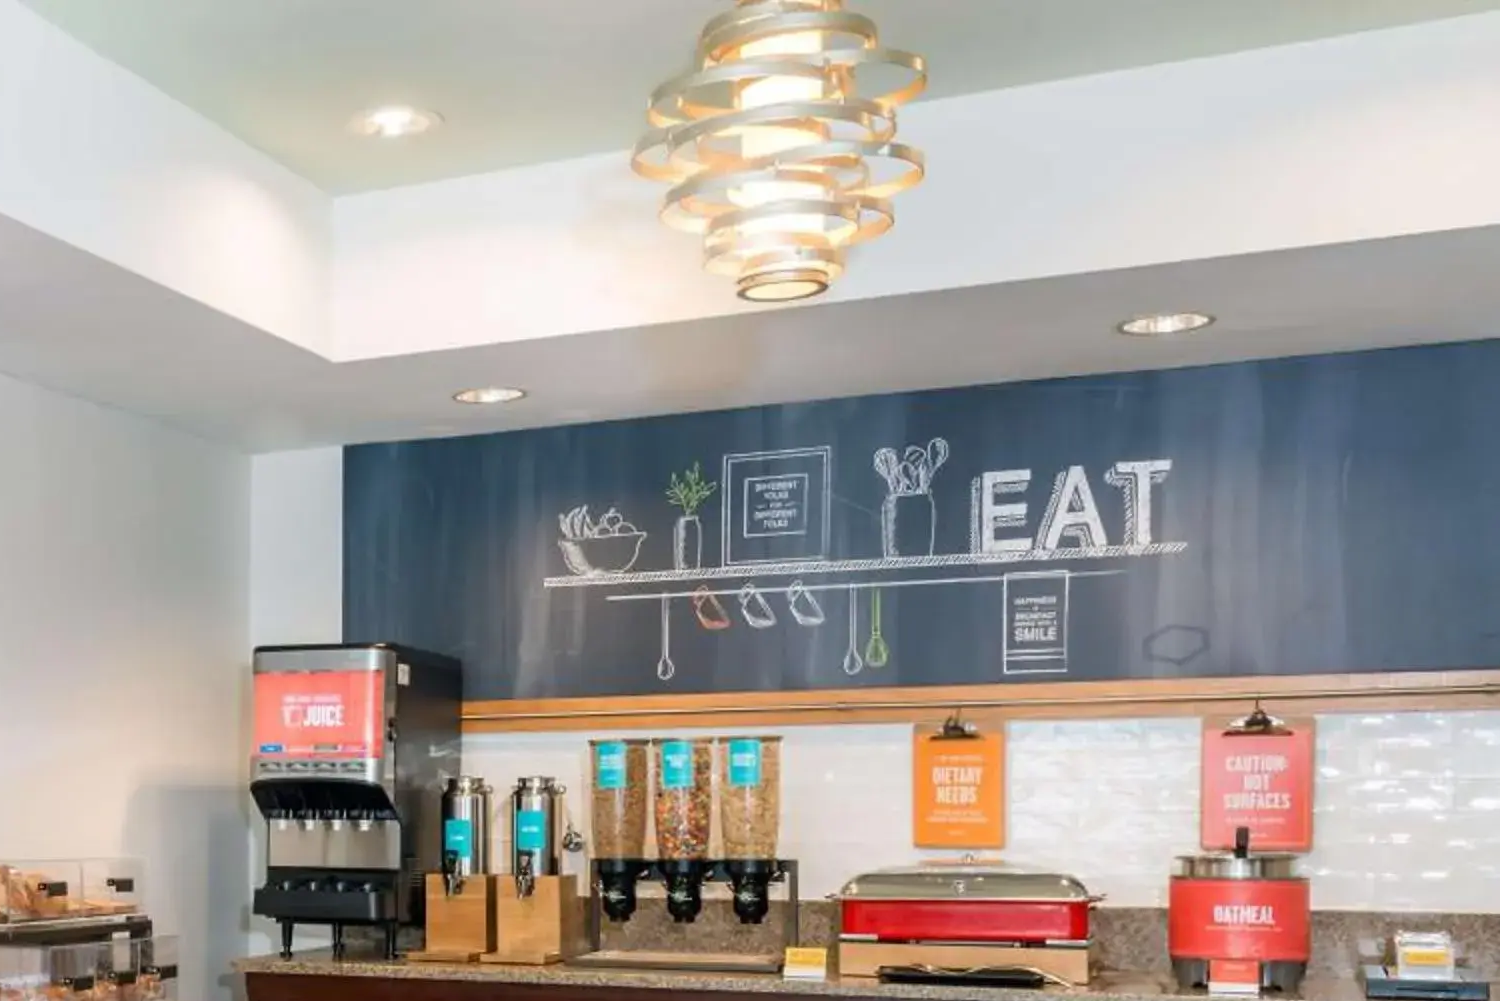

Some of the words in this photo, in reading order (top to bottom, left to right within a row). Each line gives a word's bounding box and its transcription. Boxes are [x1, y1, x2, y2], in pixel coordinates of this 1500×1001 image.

[971, 459, 1173, 552] EAT
[1014, 626, 1057, 642] SMILE
[303, 704, 346, 727] JUICE
[932, 766, 984, 785] DIETARY
[1244, 774, 1269, 791] HOT
[935, 786, 979, 805] NEEDS
[1223, 792, 1291, 810] SURFACES
[1213, 905, 1276, 924] OATMEAL
